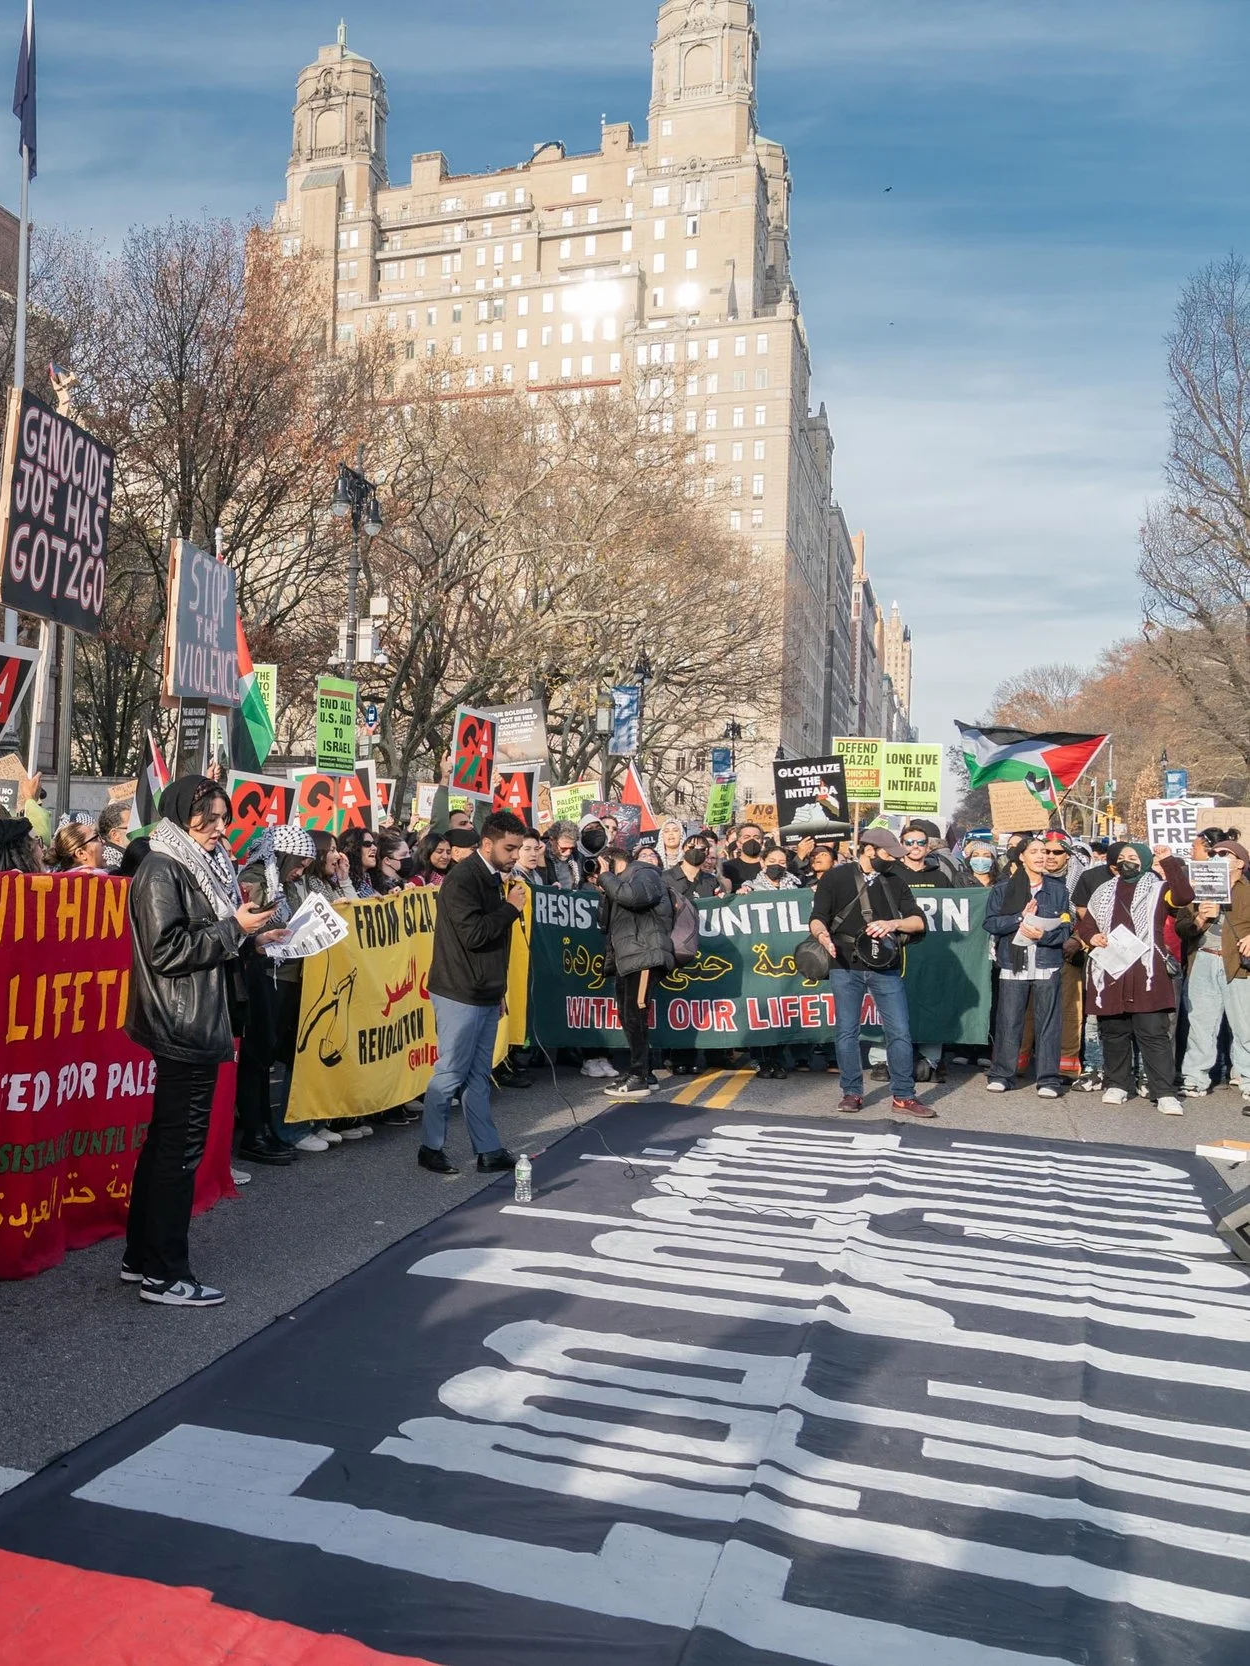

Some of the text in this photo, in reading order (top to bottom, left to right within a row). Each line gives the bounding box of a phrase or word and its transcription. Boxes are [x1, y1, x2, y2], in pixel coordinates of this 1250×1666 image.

[23, 407, 111, 508] GENOCIDE
[16, 459, 104, 557] JOE HAS
[10, 523, 106, 617] GOT2GO
[189, 553, 229, 629] STOP
[196, 615, 219, 649] THE
[178, 641, 240, 700] VIOLENCE
[320, 697, 351, 712] END ALL
[320, 712, 352, 726] U.S. AID
[499, 720, 535, 730] COUNTABLE
[334, 727, 343, 739] TO
[323, 740, 352, 754] ISRAEL
[837, 742, 878, 754] DEFEND
[886, 753, 938, 766] LONG LIVE
[777, 763, 841, 778] GLOBALIZE
[903, 766, 922, 778] THE
[798, 776, 821, 787] THE
[887, 780, 937, 793] INTIFADA
[556, 793, 595, 806] PALESTINIAN
[784, 785, 838, 799] INTIFADA
[1151, 807, 1196, 825] FRE
[1152, 827, 1197, 844] FRE
[314, 901, 341, 939] GAZA
[353, 899, 401, 950] FROM
[698, 900, 813, 938] UNTIL
[5, 969, 130, 1045] LIFETI
[667, 998, 738, 1033] OUR
[56, 1062, 97, 1107] FOR
